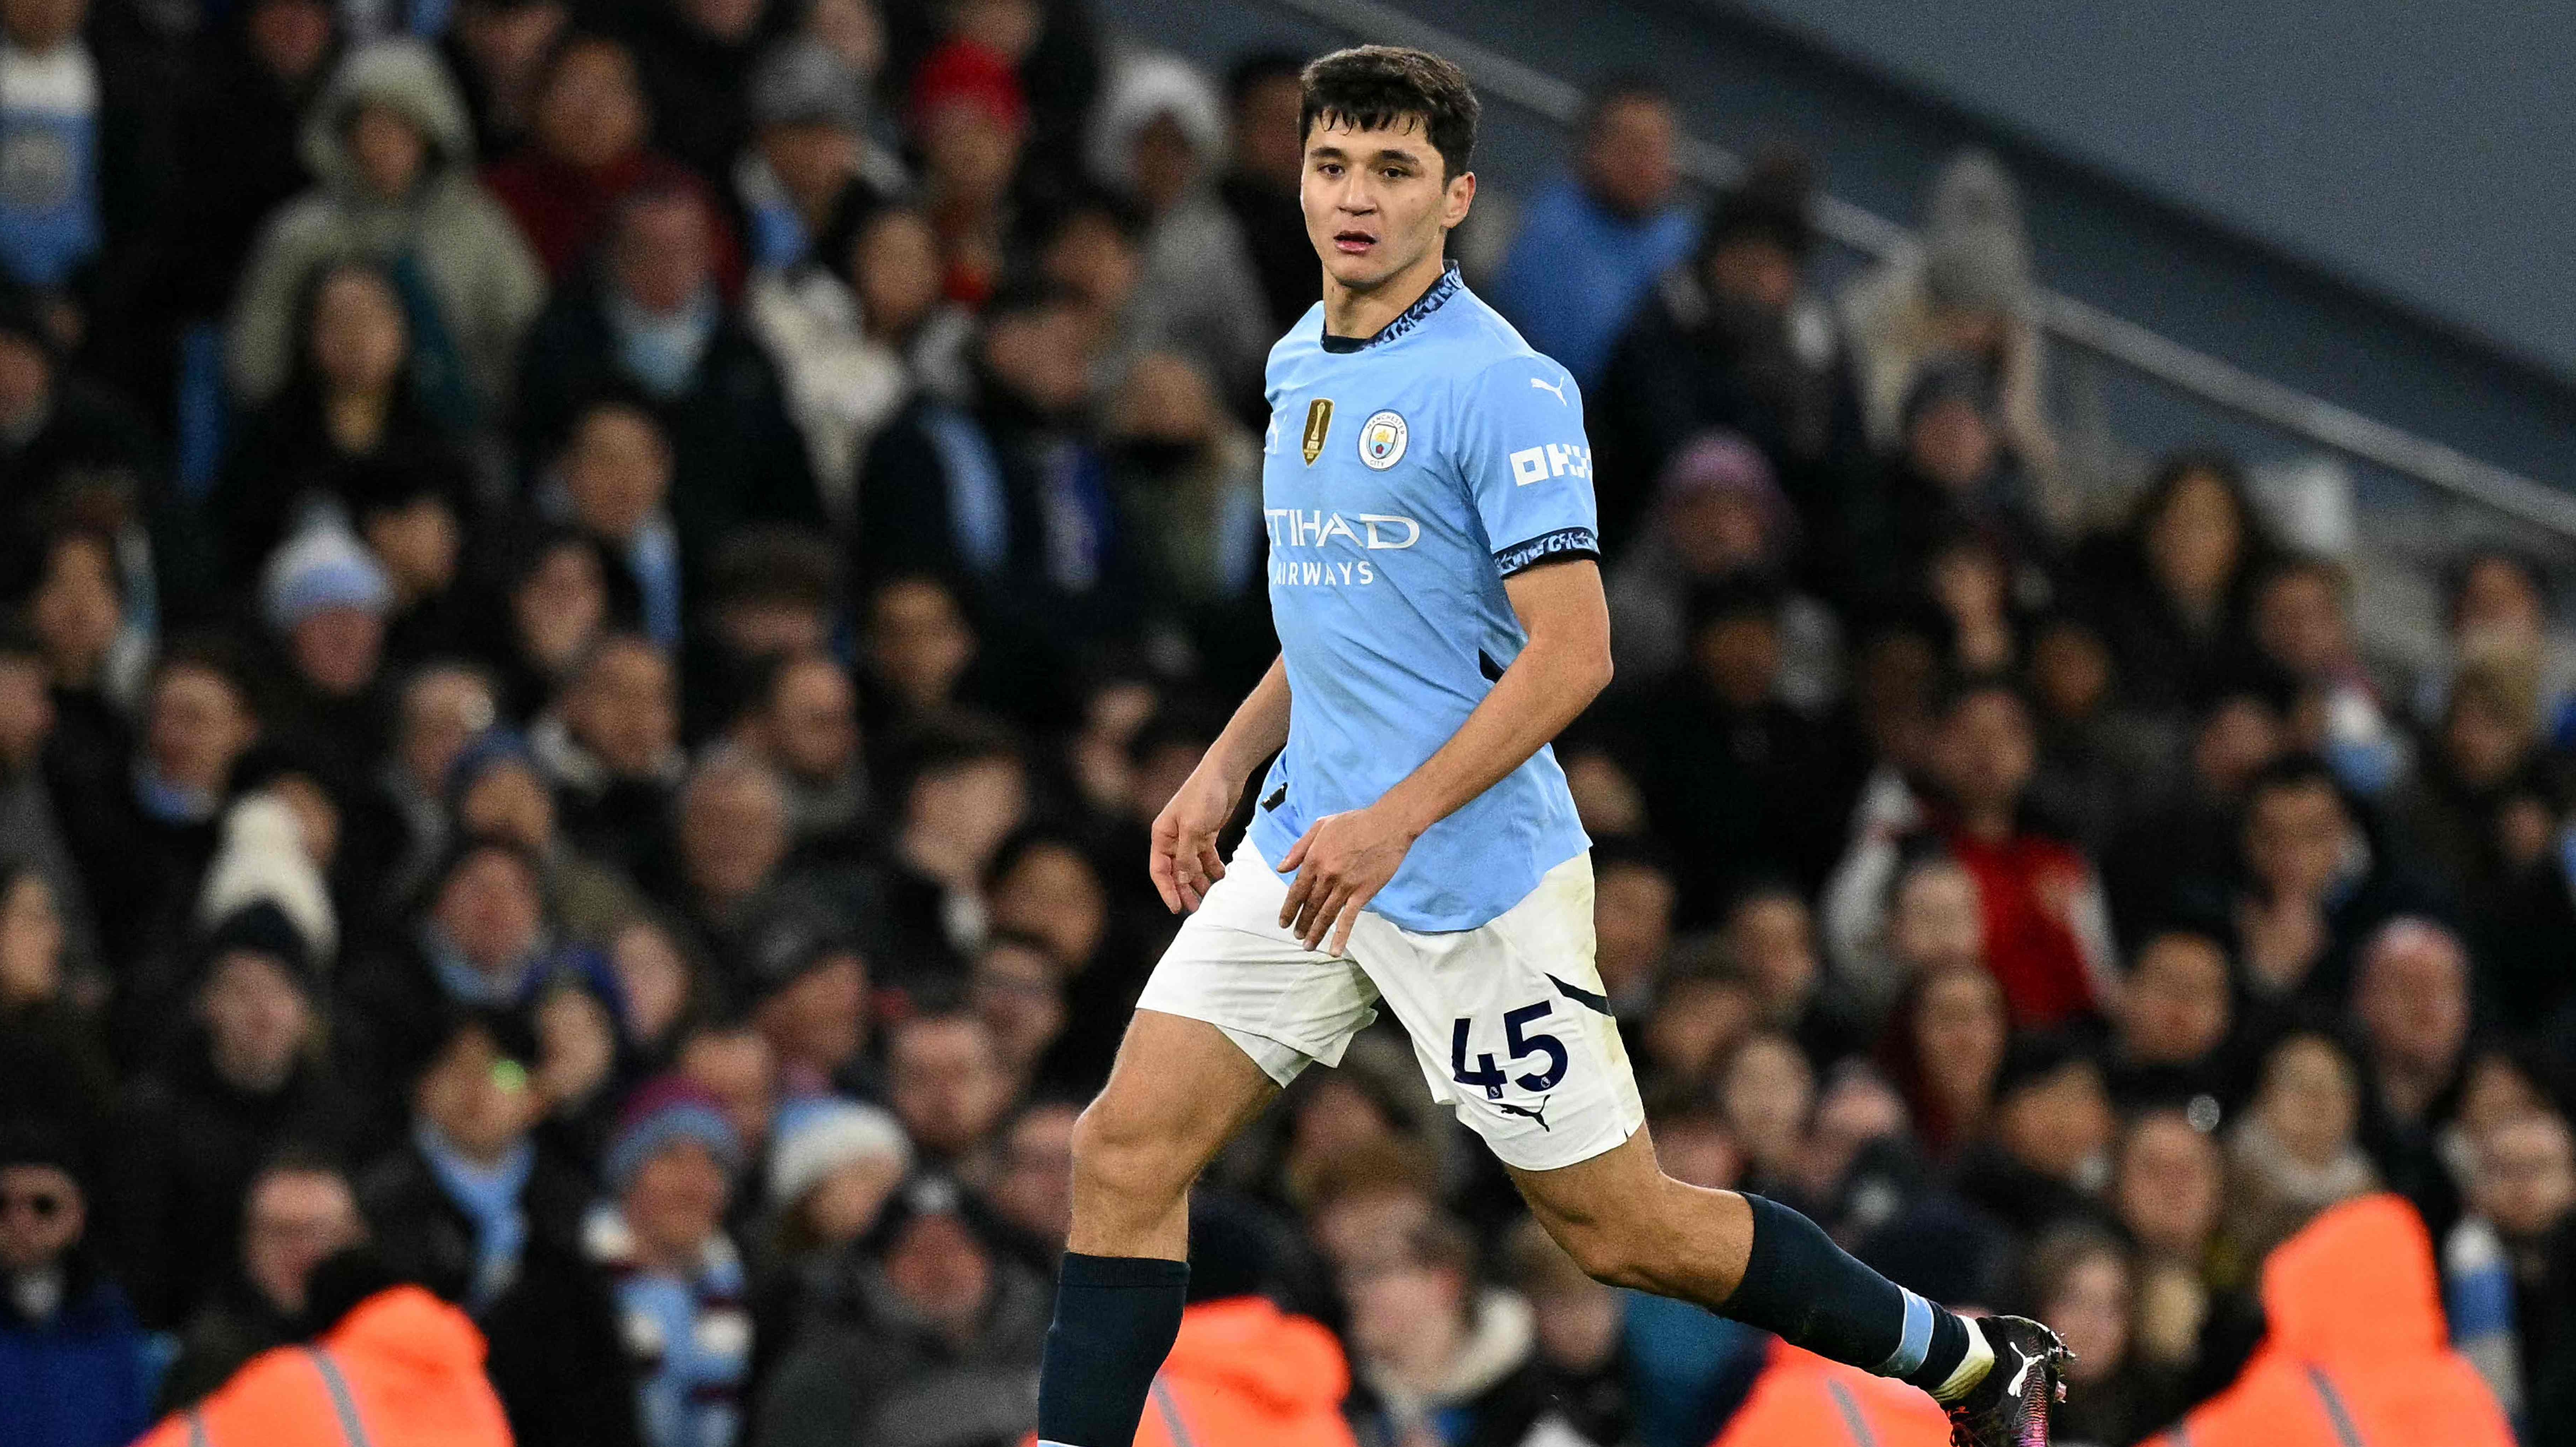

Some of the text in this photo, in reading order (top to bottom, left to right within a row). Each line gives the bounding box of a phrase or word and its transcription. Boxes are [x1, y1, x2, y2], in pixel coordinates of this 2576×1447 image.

[1367, 414, 1405, 435] MANCHESTER
[1265, 509, 1420, 549] TIHAD
[1272, 561, 1374, 586] AIRWAYS
[1452, 1000, 1568, 1100] 45
